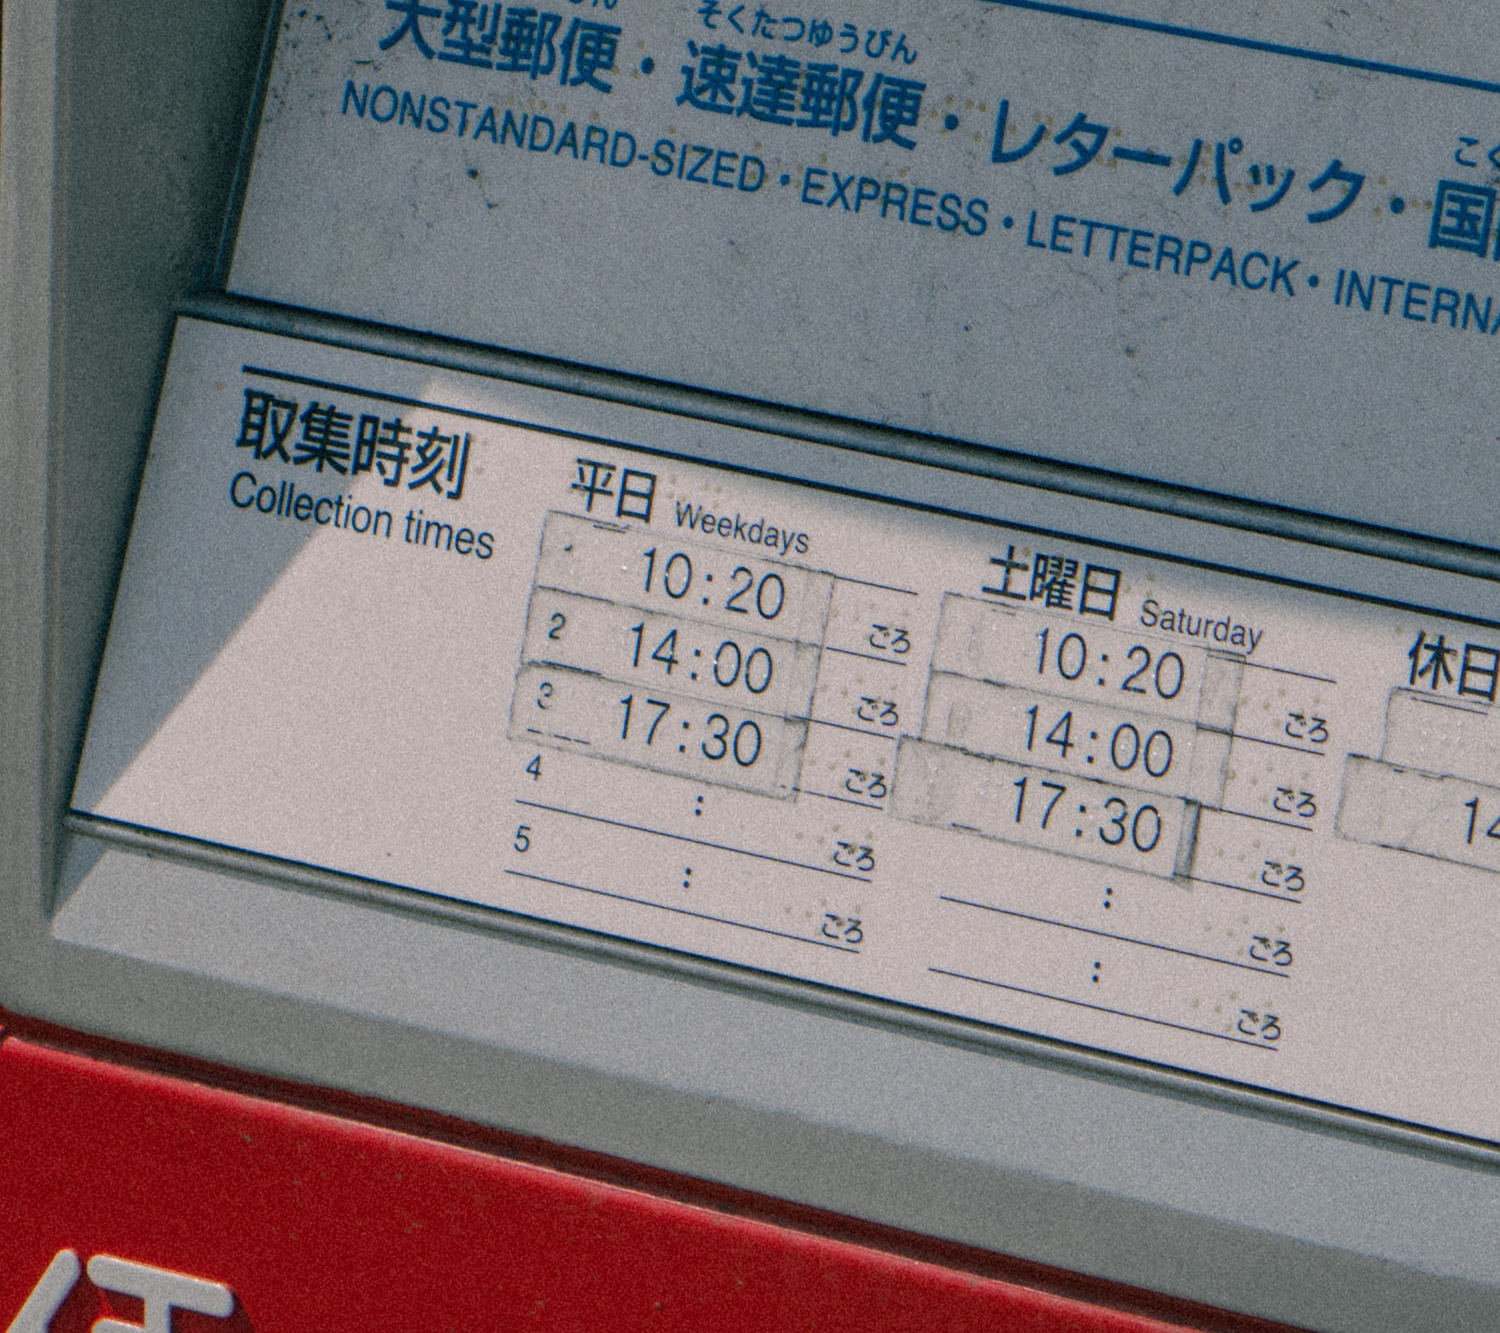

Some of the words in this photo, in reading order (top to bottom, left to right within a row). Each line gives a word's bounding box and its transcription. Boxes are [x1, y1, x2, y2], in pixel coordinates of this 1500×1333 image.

[234, 386, 473, 502] 取集時刻
[228, 470, 395, 540] Collection
[403, 515, 495, 562] times
[571, 457, 657, 524] 平日
[673, 499, 812, 557] Weekdays
[643, 546, 786, 621] 10:20
[869, 623, 912, 654] ごろ
[981, 544, 1123, 621] 土曜日
[1139, 597, 1264, 656] Saturday
[547, 611, 567, 641] 2
[630, 620, 774, 695] 14:00
[856, 694, 900, 727] ごろ
[1037, 625, 1185, 701] 10:20
[1284, 711, 1331, 744] ごろ
[618, 693, 763, 769] 17:30
[844, 766, 888, 800] ごろ
[1024, 703, 1174, 779] 14:00
[1272, 786, 1318, 819] ごろ
[524, 753, 543, 782] 4
[831, 839, 876, 873] ごろ
[1012, 775, 1162, 853] 17:30
[1260, 859, 1306, 893] ごろ
[513, 825, 532, 853] 5
[819, 911, 865, 945] ごろ
[1248, 934, 1294, 968] ごろ
[1236, 1008, 1282, 1041] ごろ
